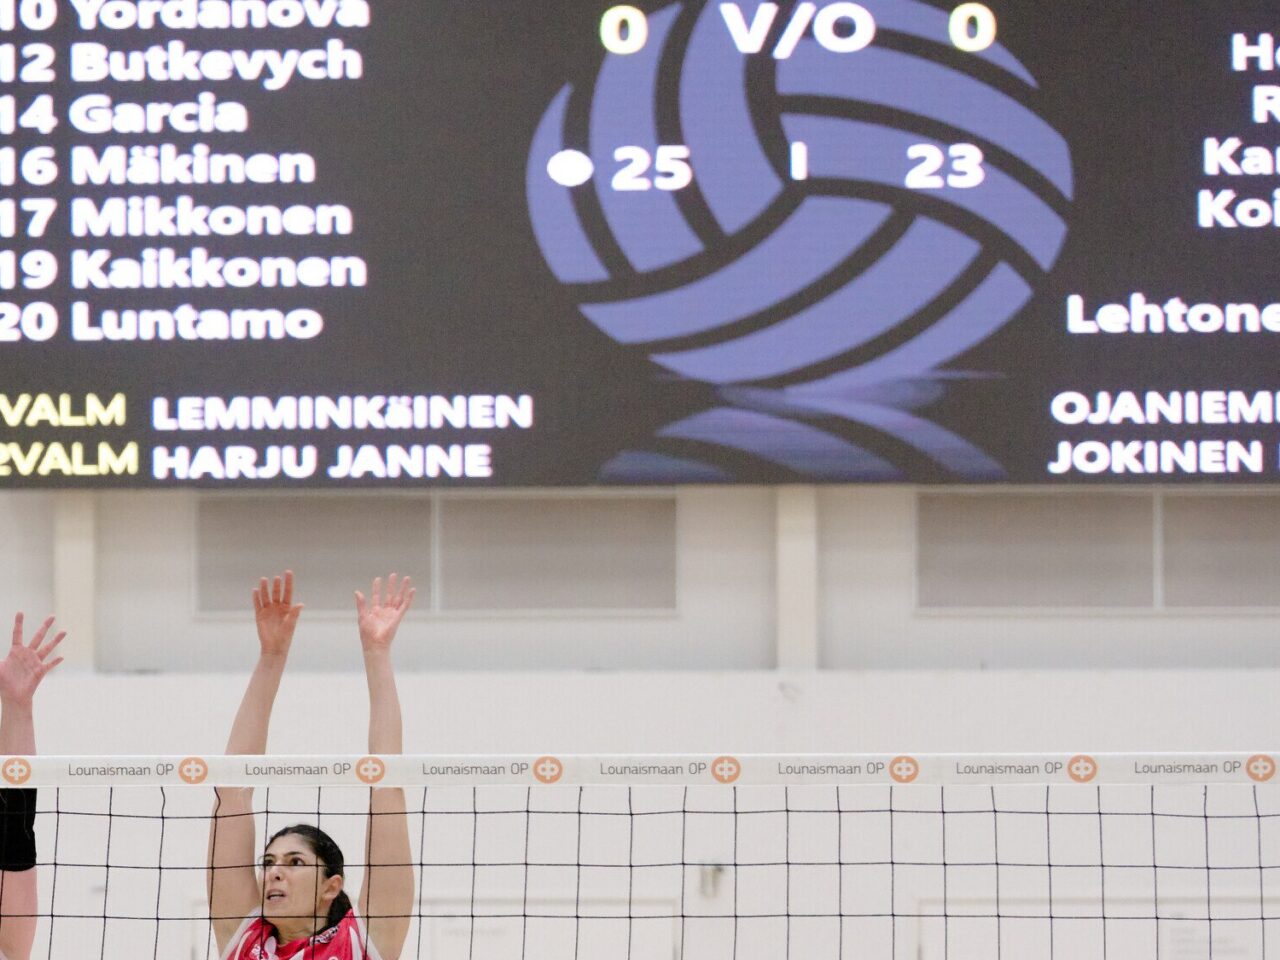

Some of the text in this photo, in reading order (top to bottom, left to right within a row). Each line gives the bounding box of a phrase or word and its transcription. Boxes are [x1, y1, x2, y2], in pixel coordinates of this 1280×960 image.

[600, 3, 997, 58] 0 V/O 0
[70, 38, 364, 93] Butkevych
[68, 90, 249, 134] Garcia
[70, 142, 316, 186] Mäkinen
[609, 147, 692, 191] 25
[905, 144, 985, 189] 23
[70, 194, 354, 238] Mikkonen
[70, 246, 368, 290] Kaikkonen
[71, 300, 324, 342] Luntamo
[152, 444, 318, 480] HARJU
[327, 443, 493, 479] JANNE
[1047, 440, 1263, 474] JOKINEN
[68, 763, 175, 777] Lounaismaan OP
[245, 762, 352, 776] Lounaismaan OP
[422, 762, 529, 776] Lounaismaan OP
[600, 762, 707, 775] Lounaismaan OP
[777, 761, 885, 775] Lounaismaan OP
[956, 761, 1063, 775] Lounaismaan OP
[1134, 761, 1242, 774] Lounaismaan OP
